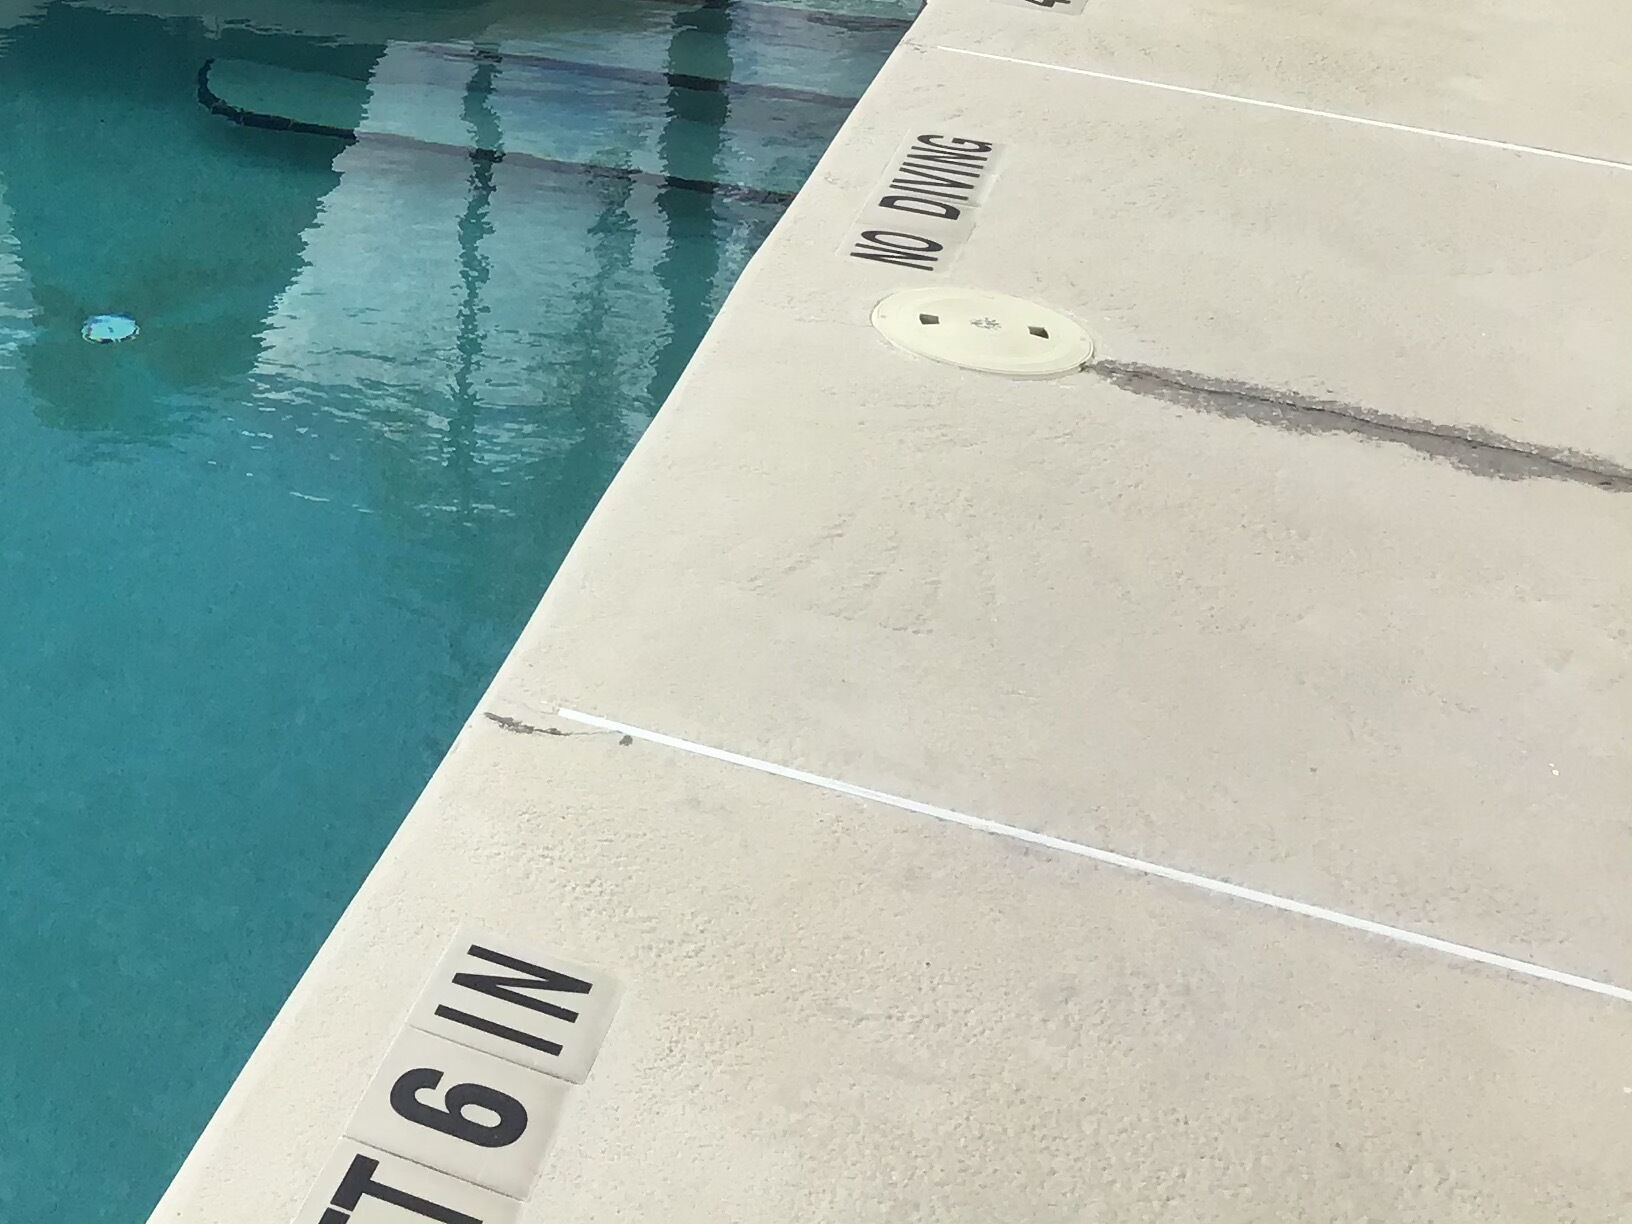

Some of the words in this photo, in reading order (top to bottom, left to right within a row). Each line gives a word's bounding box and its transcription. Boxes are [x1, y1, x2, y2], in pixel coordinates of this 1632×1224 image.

[878, 134, 993, 221] DIVING
[850, 229, 944, 272] NO
[433, 944, 594, 1057] IN
[389, 1067, 529, 1149] 6
